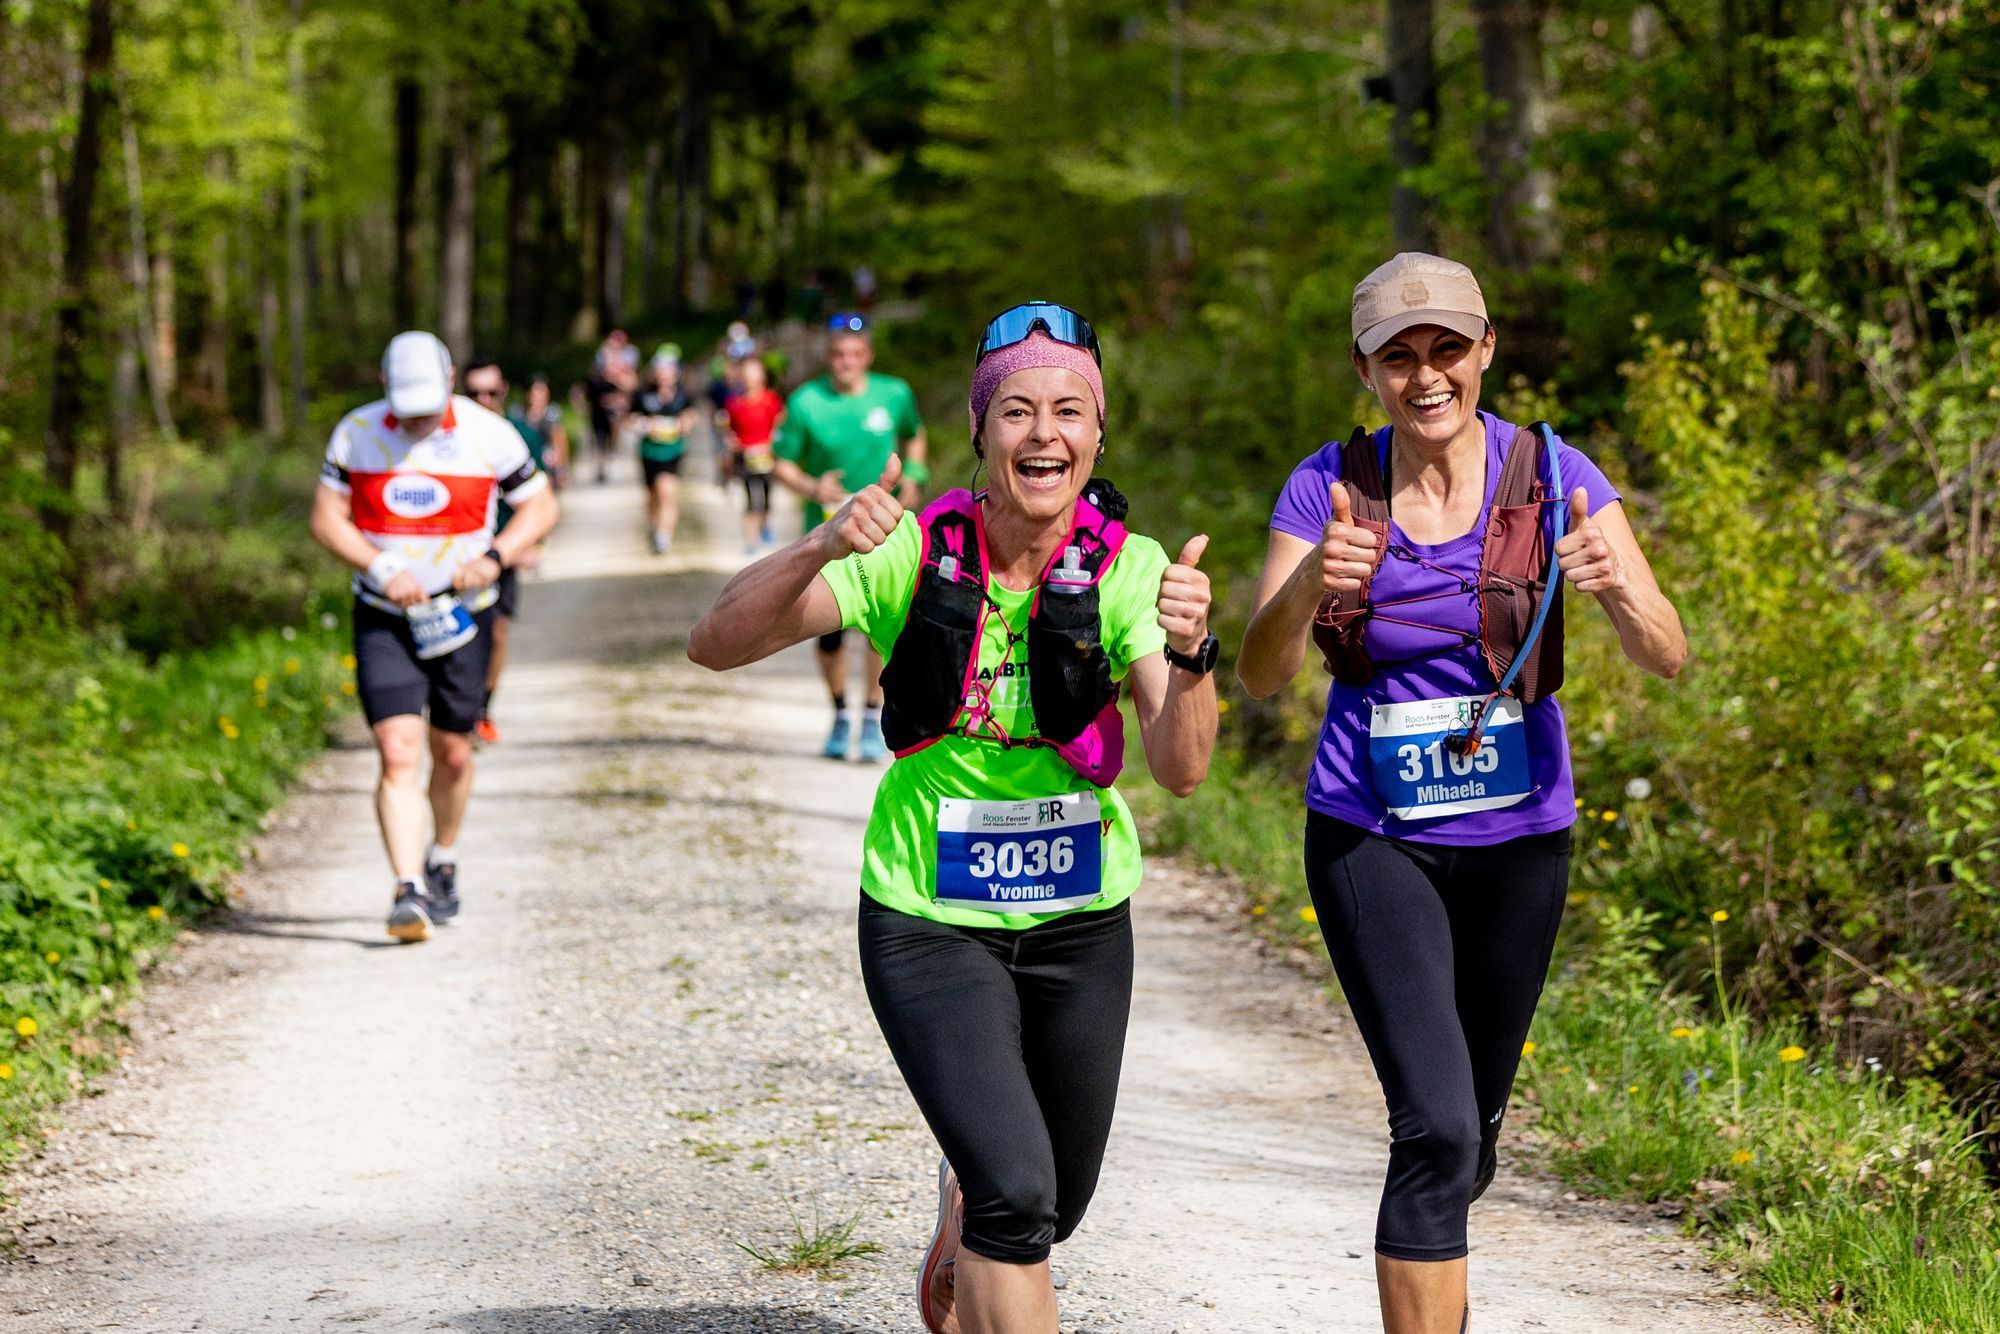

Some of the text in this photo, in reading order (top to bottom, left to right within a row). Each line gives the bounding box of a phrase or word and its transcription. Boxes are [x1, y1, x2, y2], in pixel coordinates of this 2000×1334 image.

[1405, 713, 1450, 723] Roos Fenster
[1417, 780, 1485, 803] Mihaela
[983, 813, 1004, 822] Roos
[969, 836, 1074, 878] 3036
[988, 883, 1056, 900] Yvonne
